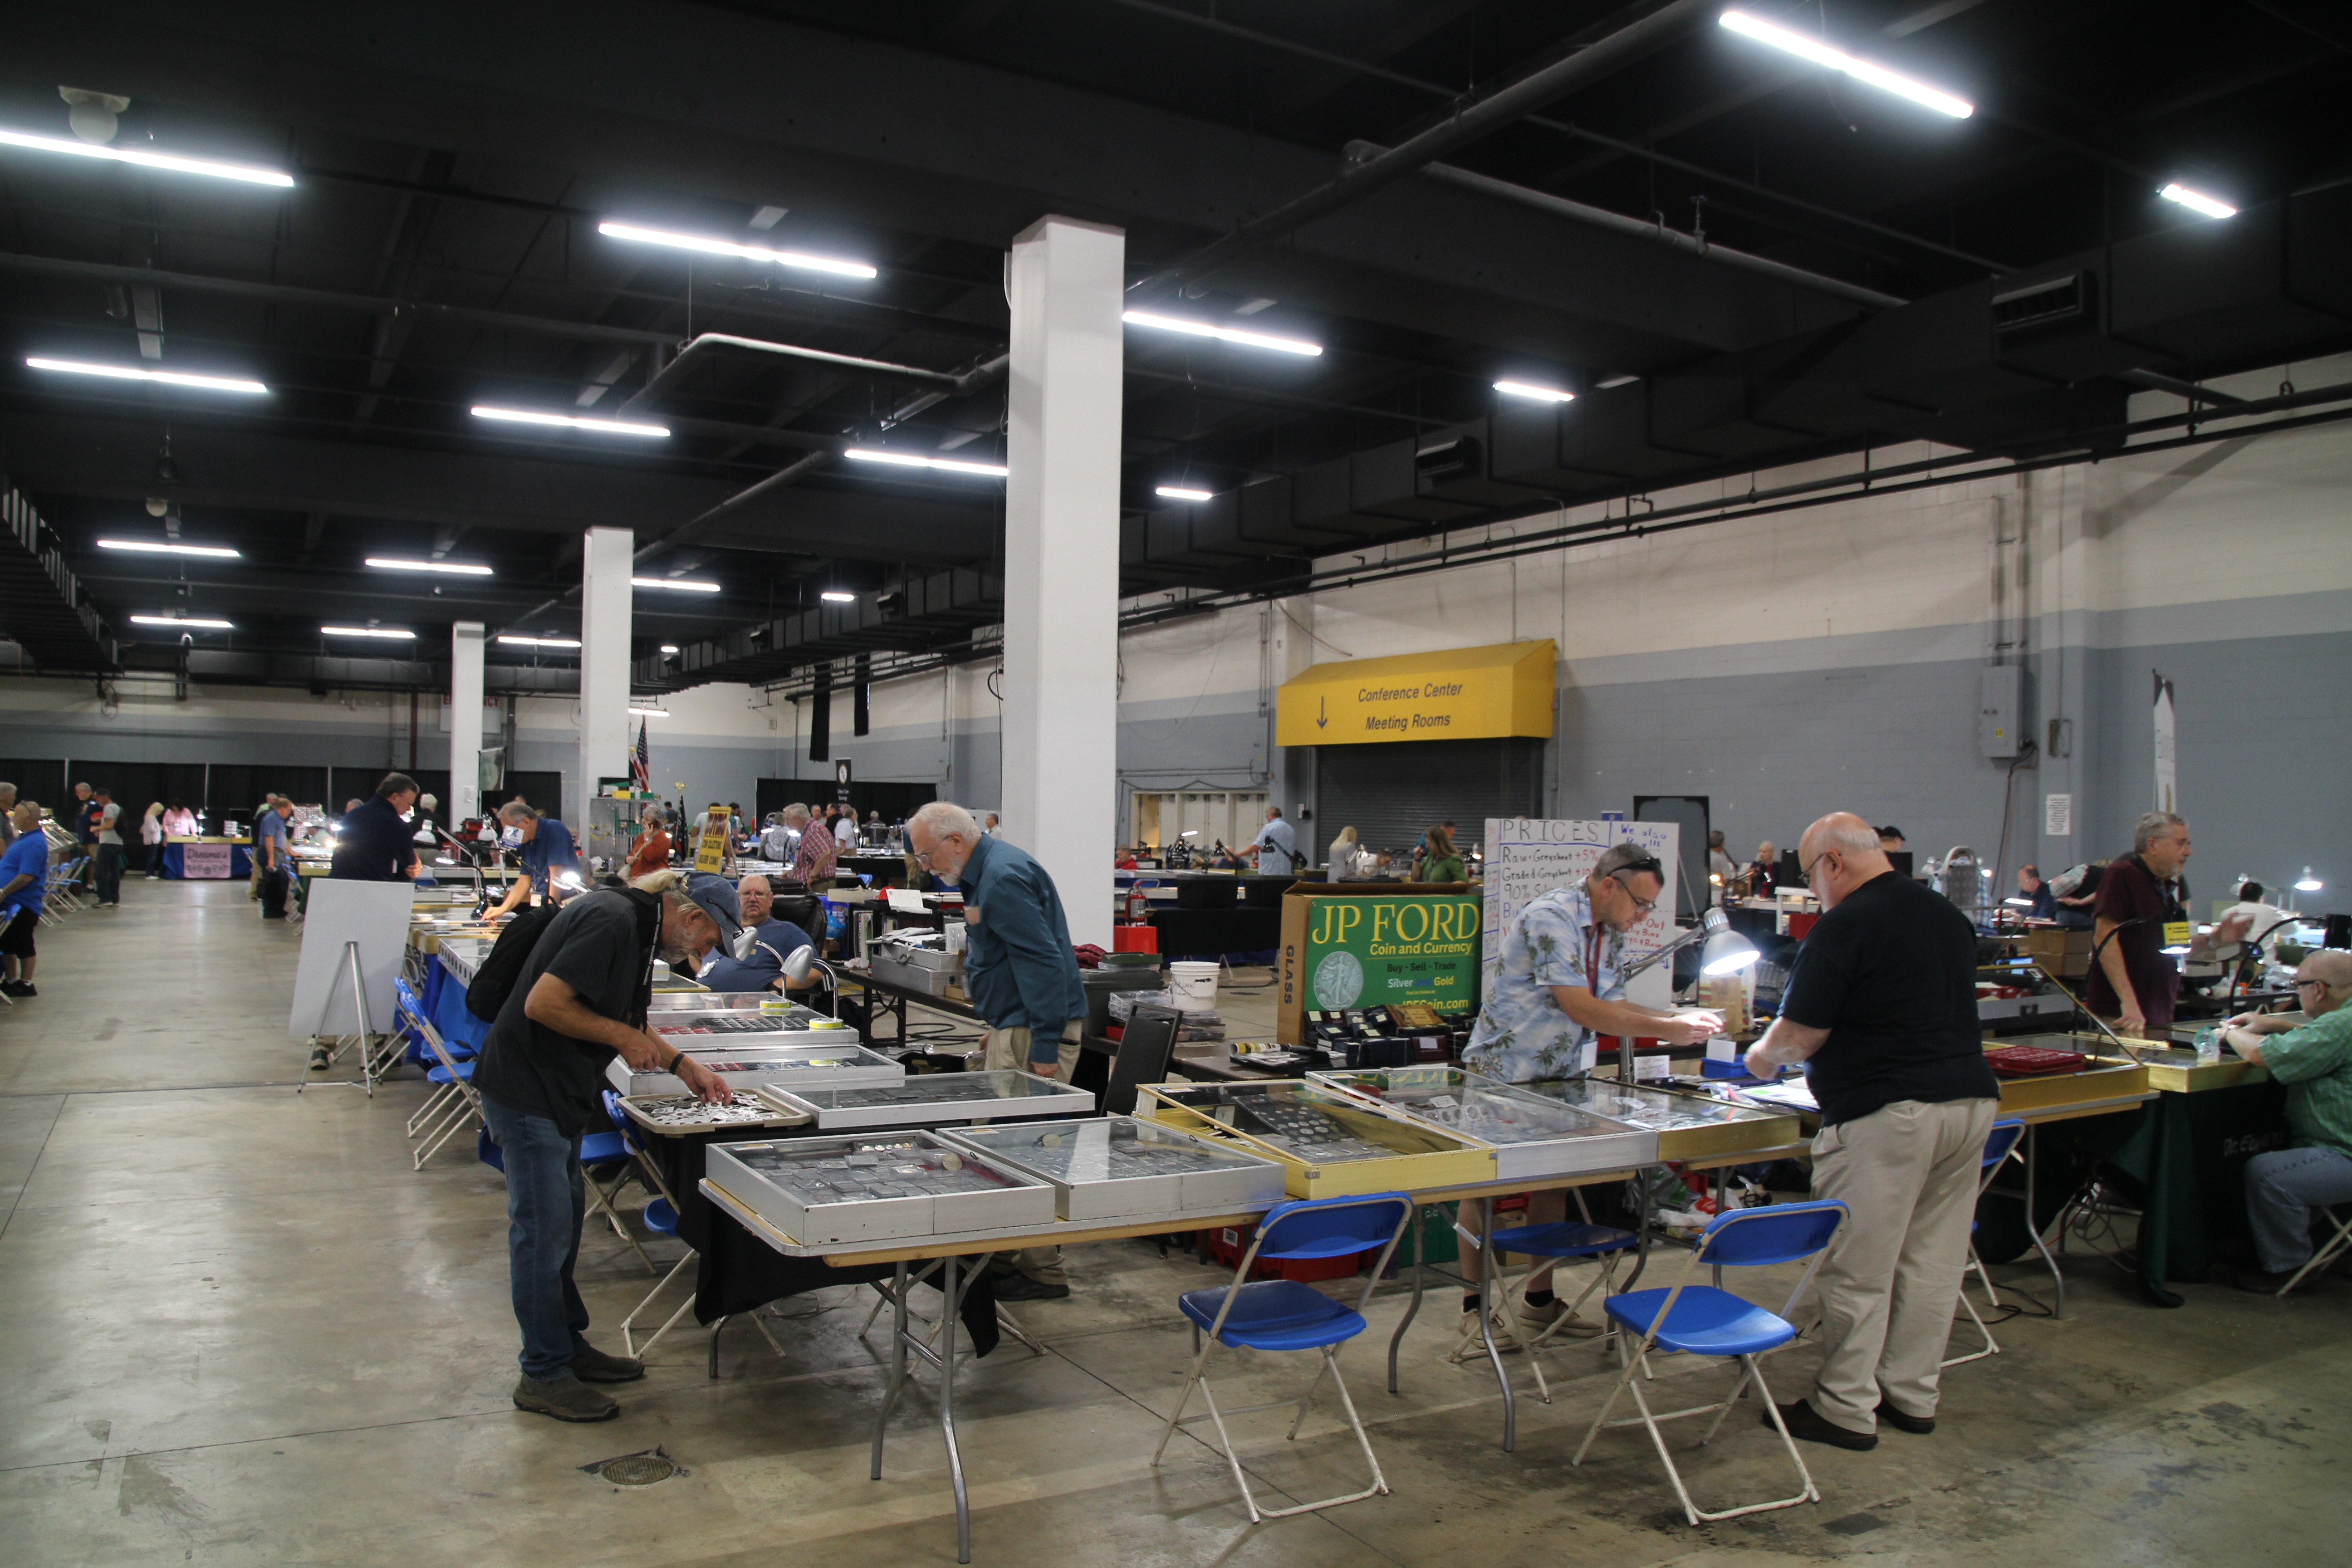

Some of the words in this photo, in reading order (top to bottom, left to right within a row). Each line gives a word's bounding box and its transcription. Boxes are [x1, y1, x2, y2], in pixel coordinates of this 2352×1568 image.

[1358, 687, 1420, 702] Conference
[1424, 683, 1463, 698] Center
[1365, 715, 1408, 732] Meeting
[1412, 714, 1450, 728] Rooms
[1503, 820, 1598, 842] PRICES
[1621, 824, 1634, 835] We
[1642, 828, 1667, 839] also
[1504, 884, 1530, 900] 90%
[1312, 905, 1361, 945] JP
[1370, 902, 1480, 941] FORD
[1646, 918, 1665, 931] Out
[1370, 942, 1396, 956] Coin
[1398, 942, 1421, 955] and
[1423, 942, 1473, 955] Currency
[1284, 945, 1294, 1004] GLASS
[1387, 963, 1403, 974] Buy
[1410, 962, 1426, 971] Sell
[1434, 961, 1456, 970] Trade
[1387, 978, 1413, 988] Silver
[1434, 975, 1455, 986] Gold
